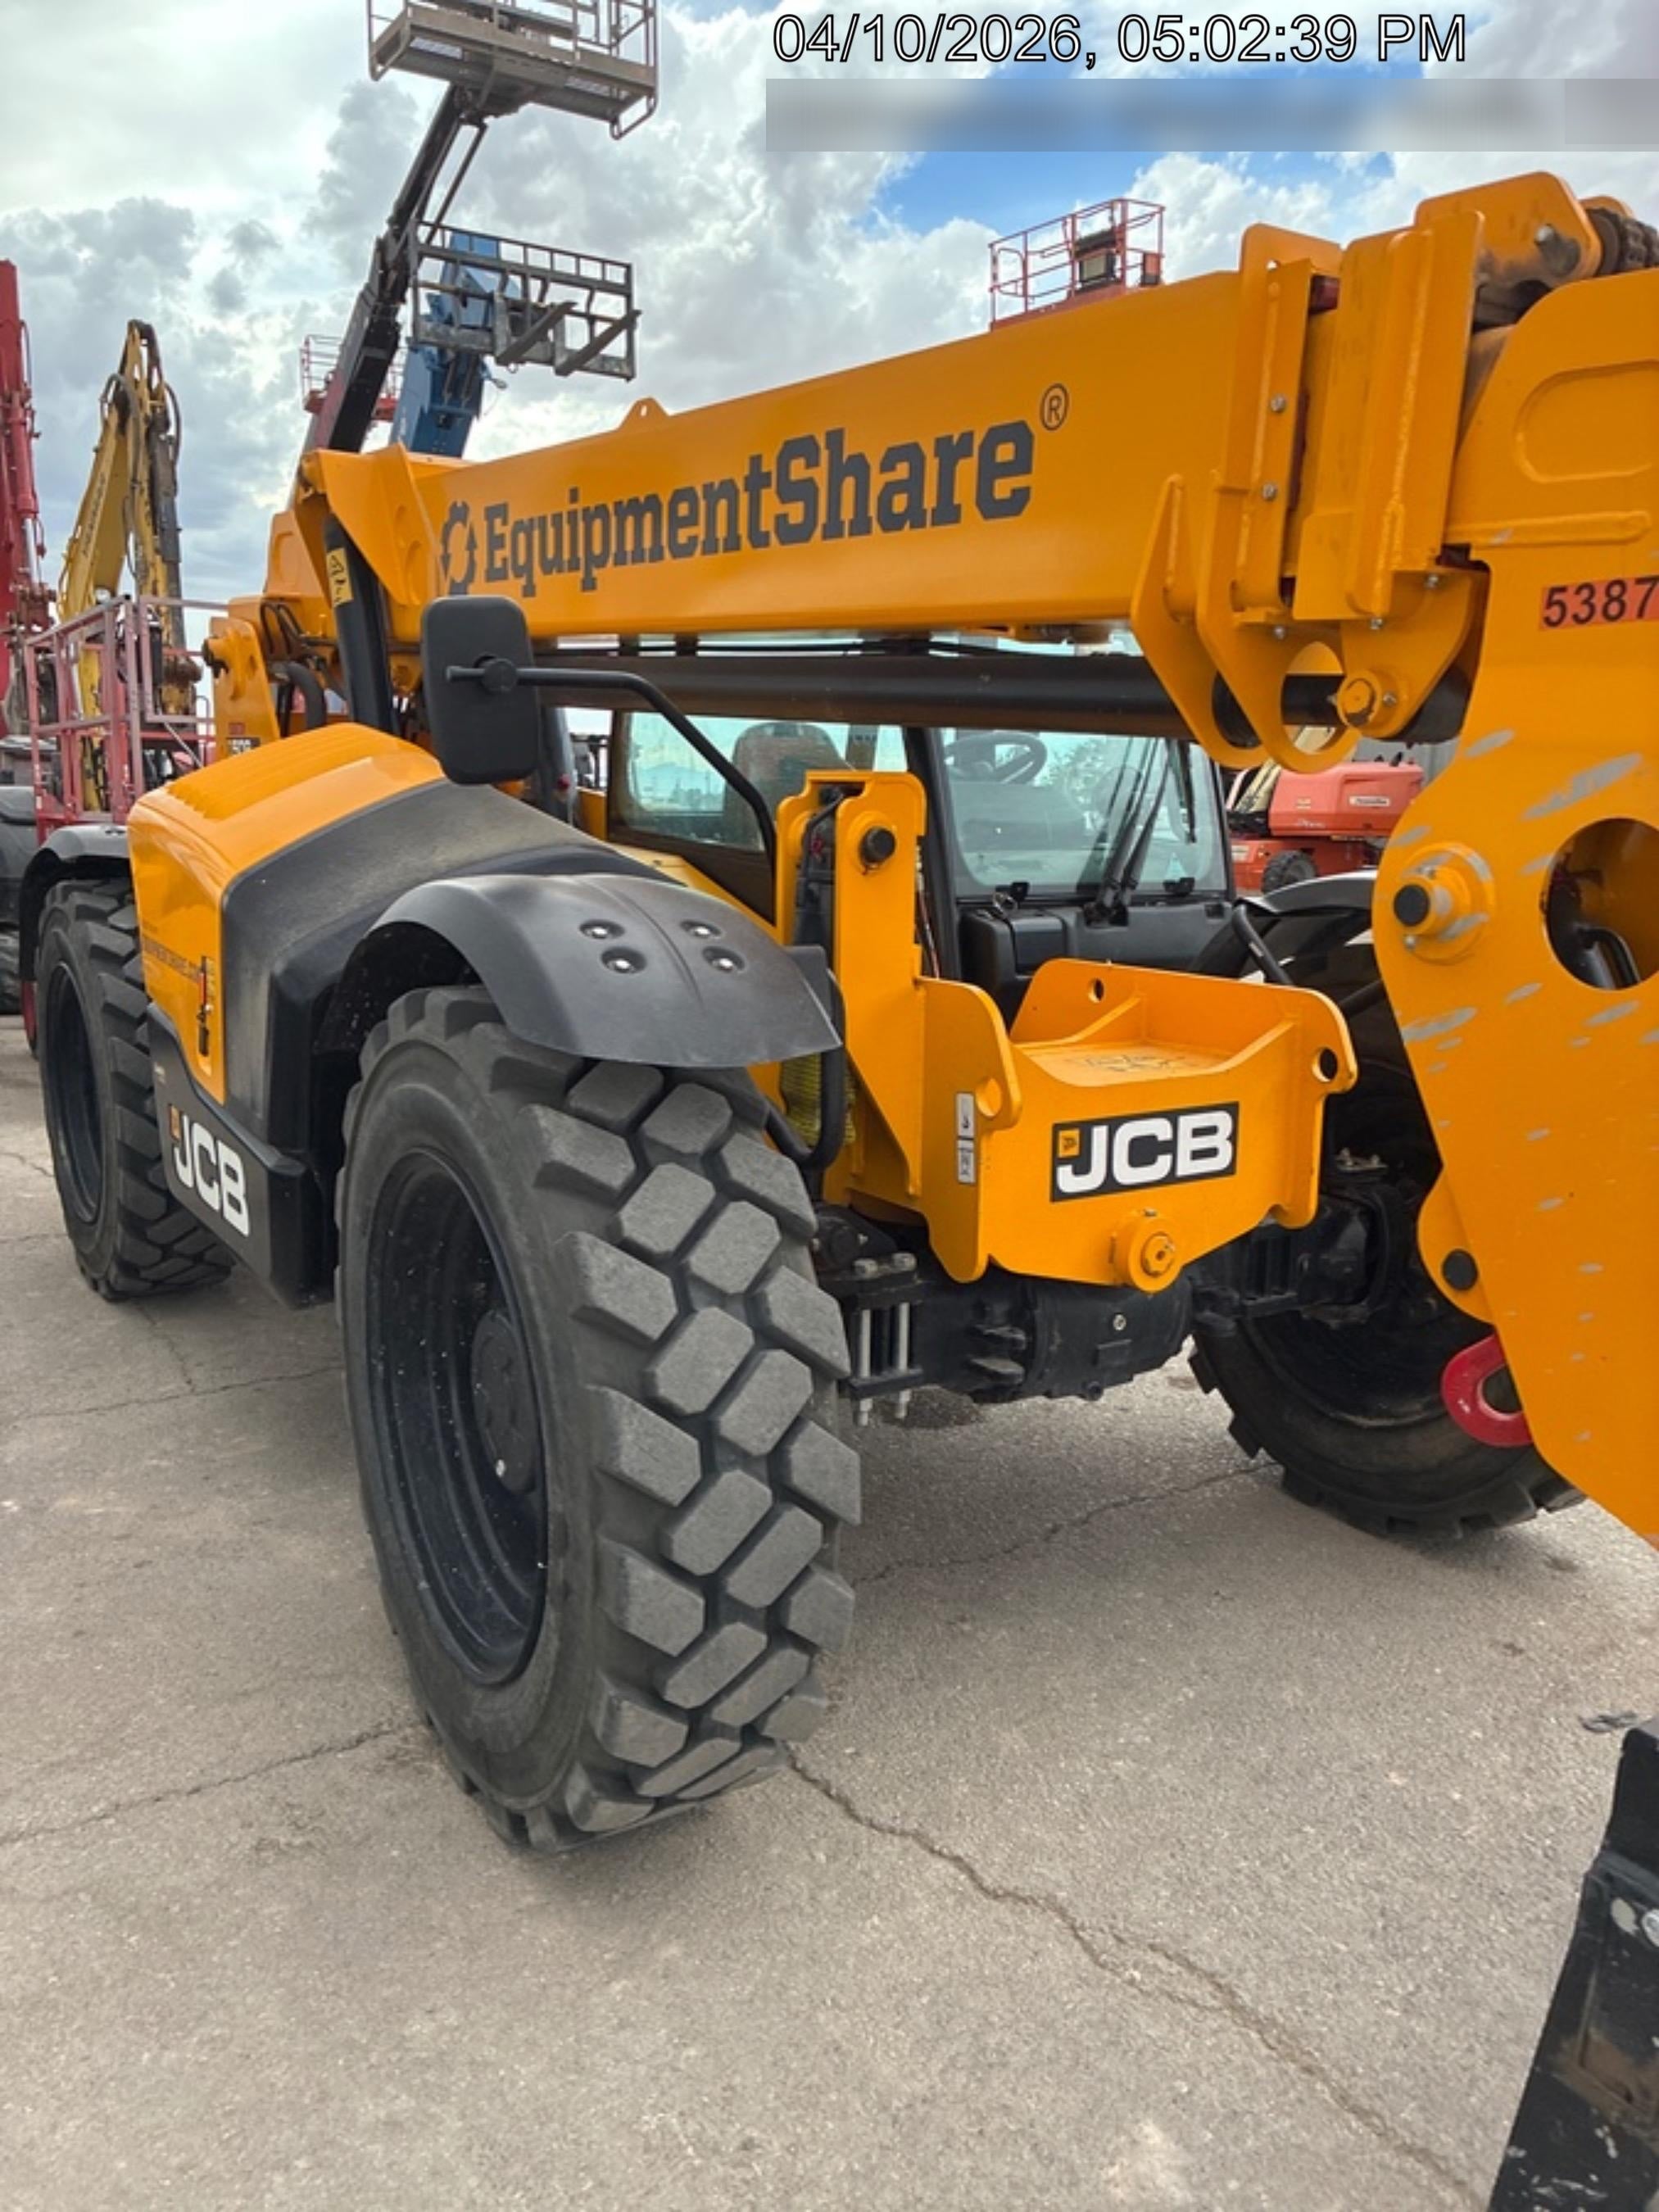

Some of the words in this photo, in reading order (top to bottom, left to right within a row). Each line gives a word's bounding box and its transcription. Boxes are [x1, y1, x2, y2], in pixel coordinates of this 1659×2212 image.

[1543, 574, 1659, 628] 5387
[174, 1114, 249, 1236] JCB
[1057, 1111, 1233, 1193] JCB
